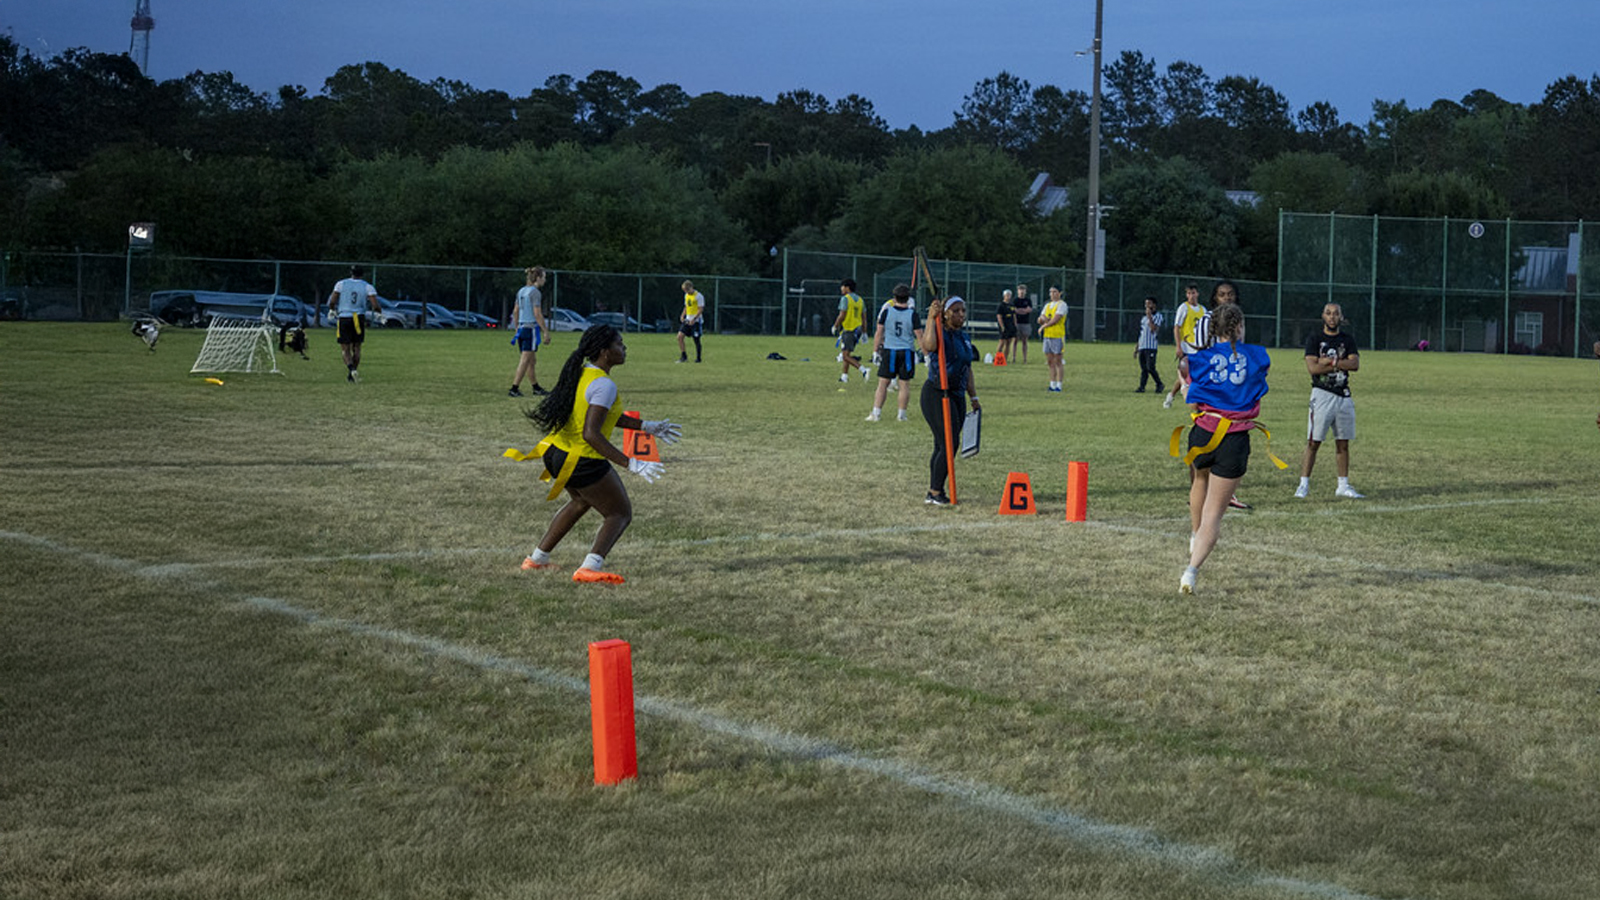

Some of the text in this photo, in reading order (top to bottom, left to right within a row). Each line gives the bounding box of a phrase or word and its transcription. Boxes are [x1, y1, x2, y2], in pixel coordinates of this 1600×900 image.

[351, 291, 357, 304] 3
[895, 321, 903, 337] 5
[1209, 352, 1247, 385] 33
[633, 432, 651, 455] G
[1010, 483, 1028, 510] G
